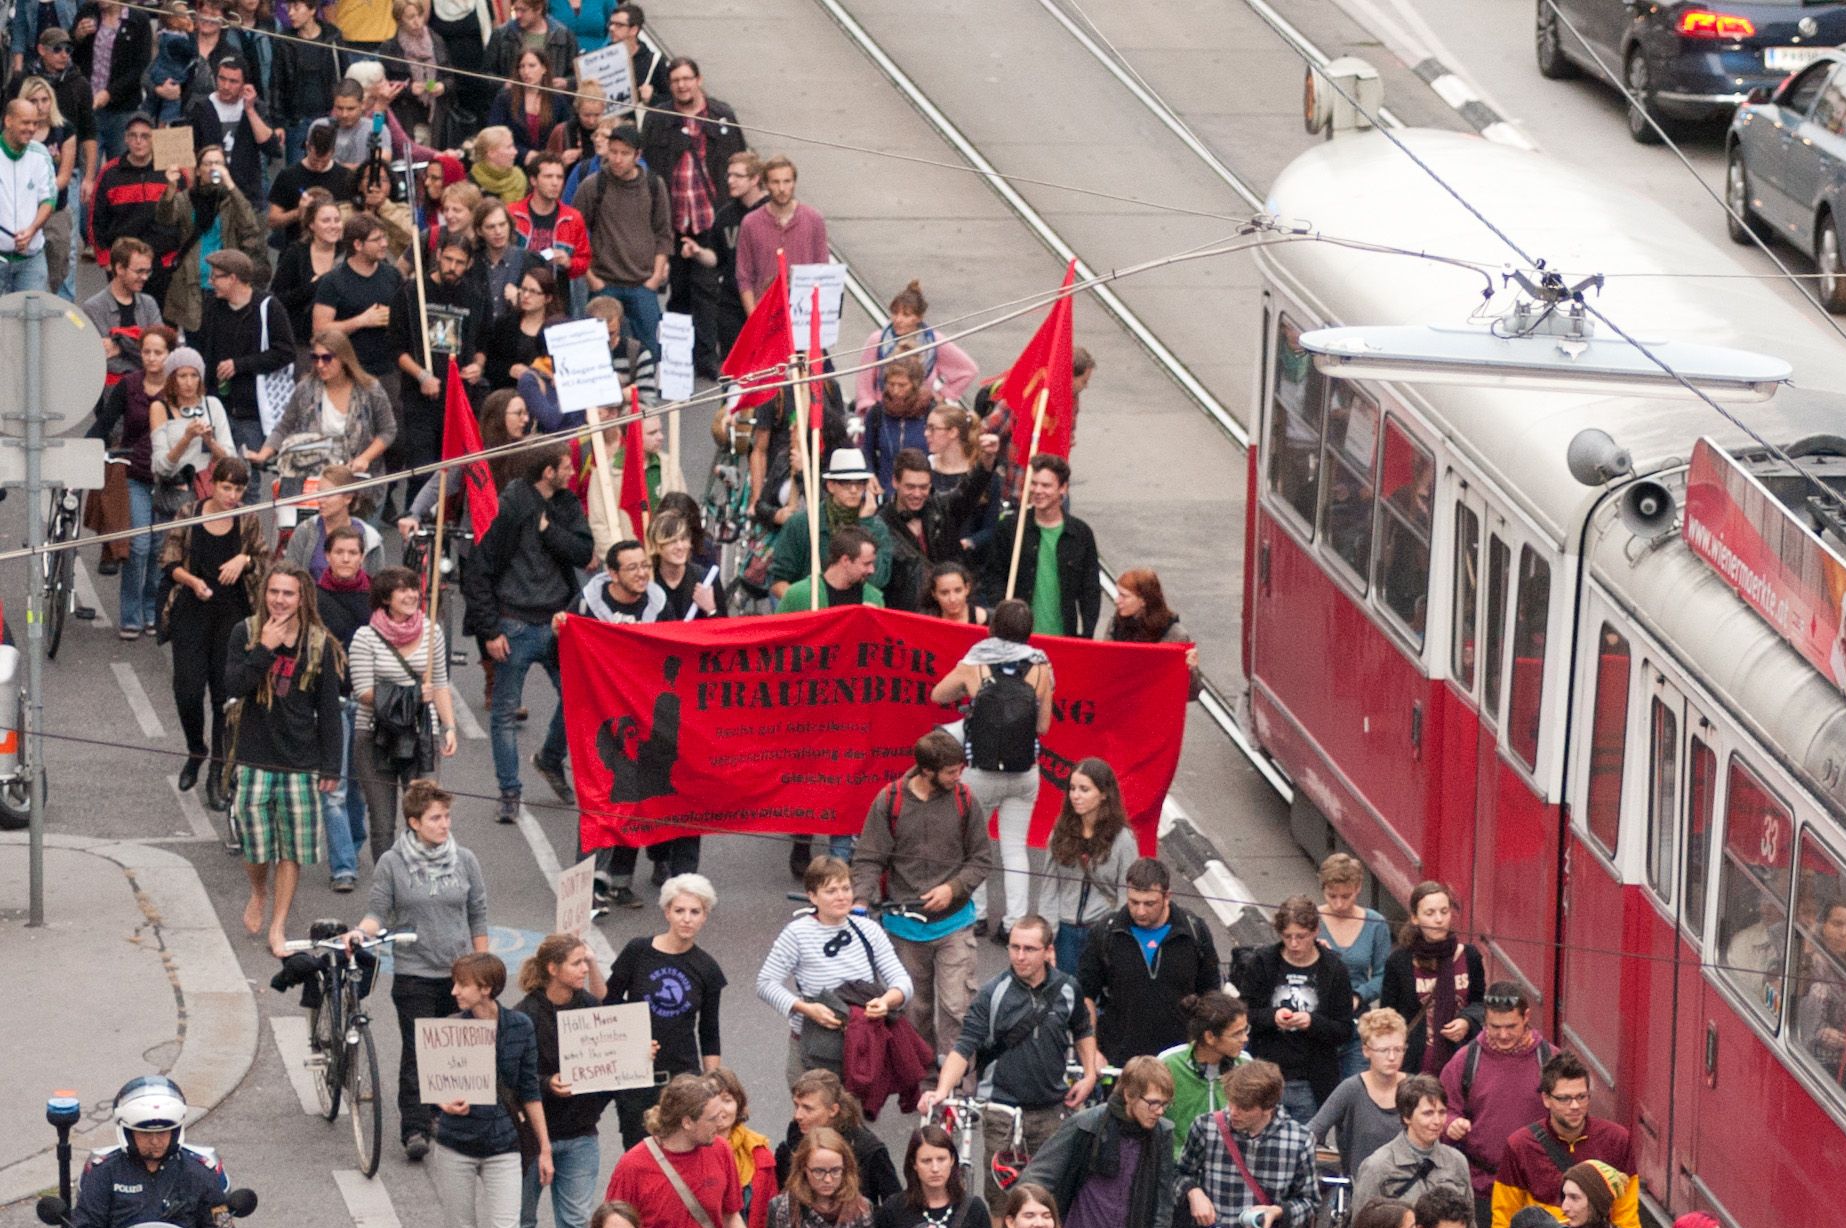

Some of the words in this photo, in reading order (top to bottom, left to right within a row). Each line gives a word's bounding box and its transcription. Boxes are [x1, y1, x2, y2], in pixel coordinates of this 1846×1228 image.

[1687, 513, 1789, 629] www.wienermaerkte.at
[698, 643, 841, 674] KAMPF
[856, 637, 938, 677] FÜR
[1760, 814, 1779, 864] 33
[650, 967, 692, 992] SEXISMUS
[592, 1012, 618, 1029] Maria
[422, 1025, 497, 1049] MASTURBATION
[427, 1073, 491, 1092] KOMMUNION
[571, 1060, 617, 1081] ERSPART
[113, 1183, 143, 1194] POLIZEI
